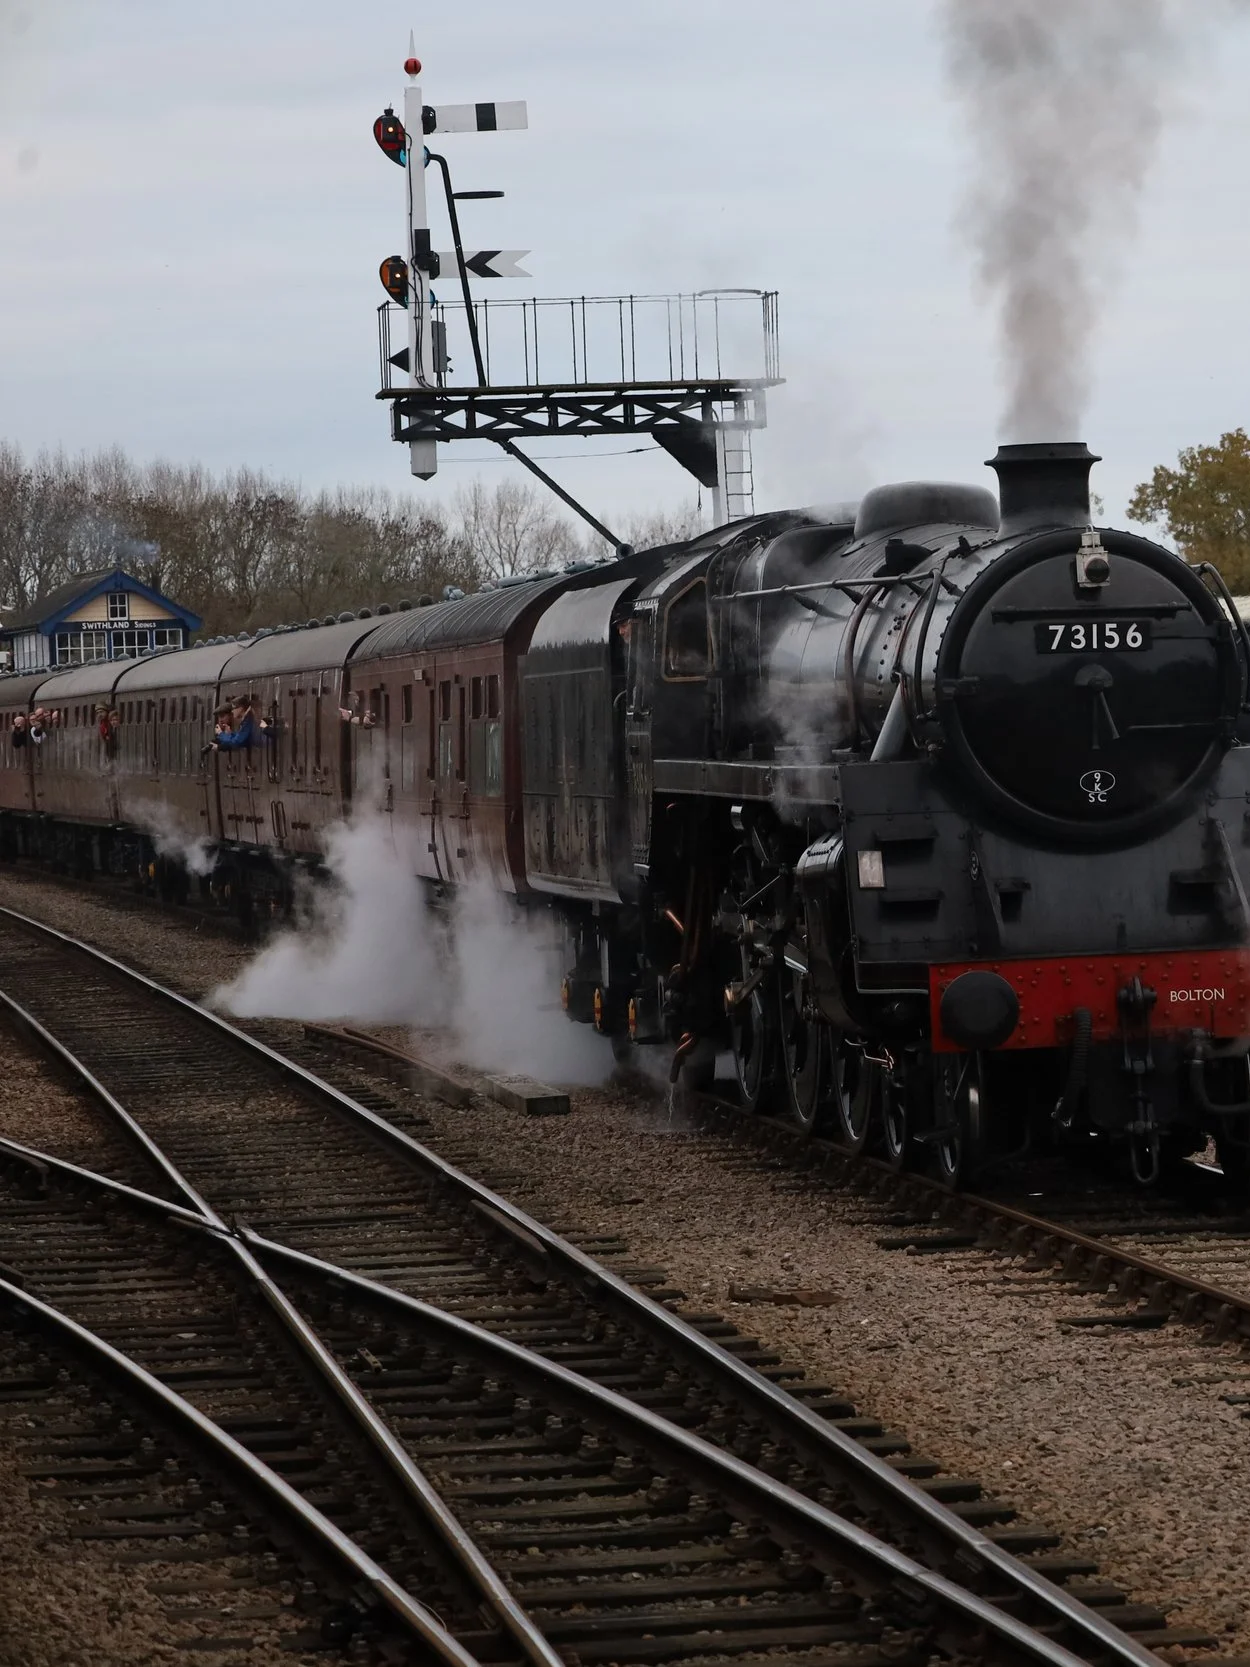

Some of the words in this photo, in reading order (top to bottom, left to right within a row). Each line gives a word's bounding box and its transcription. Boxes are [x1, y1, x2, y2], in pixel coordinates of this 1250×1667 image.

[82, 621, 129, 630] SWITHLAND
[1049, 623, 1143, 650] 73156
[1094, 772, 1101, 782] 9
[1094, 783, 1102, 791] K
[1170, 988, 1225, 1002] BOLTON
